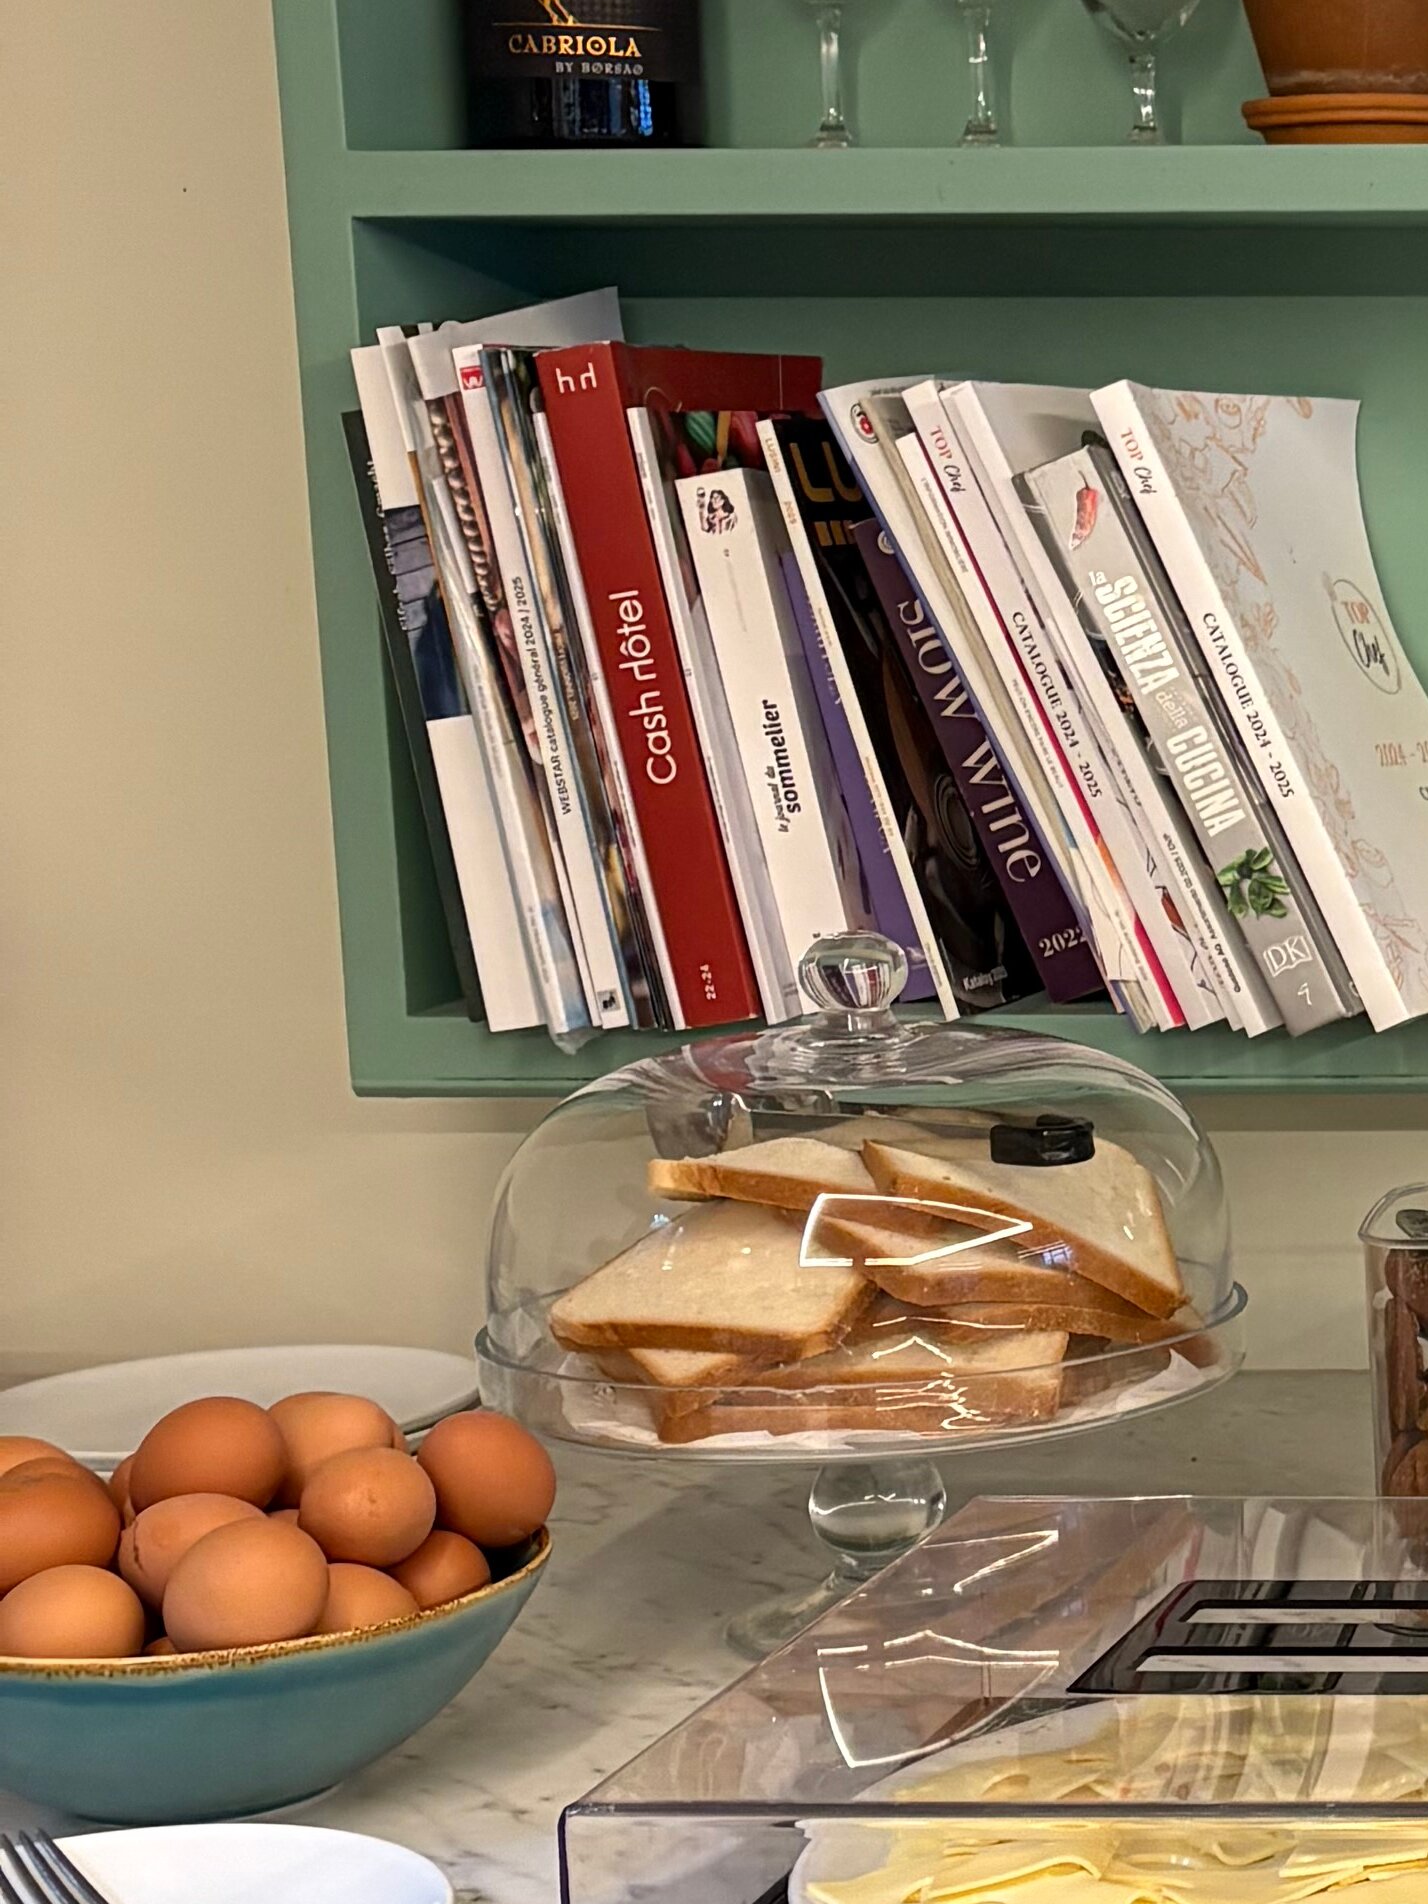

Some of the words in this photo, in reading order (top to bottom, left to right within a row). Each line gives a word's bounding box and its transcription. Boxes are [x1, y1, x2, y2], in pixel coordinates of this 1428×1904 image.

[508, 34, 642, 58] CABRIOLA
[555, 61, 574, 74] BY
[929, 425, 953, 460] TOP
[1119, 427, 1144, 462] TOP
[511, 575, 528, 605] 2025
[1088, 571, 1107, 586] la
[521, 616, 537, 644] 2024
[1341, 601, 1371, 626] TOP
[1094, 574, 1180, 695] SCIENZA
[539, 688, 559, 753] catalogue
[1011, 611, 1065, 708] CATALOGUE
[1056, 708, 1080, 748] 2024
[1078, 761, 1103, 799] 2025
[1154, 690, 1190, 729] della
[1202, 612, 1256, 709] CATALOGUE
[1247, 709, 1272, 749] 2024
[1269, 761, 1295, 799] 2025
[628, 690, 678, 786] Cash
[1375, 743, 1407, 768] 2024
[761, 698, 802, 815] sommelier
[549, 753, 571, 815] WEBSTAR
[1166, 724, 1247, 838] CUCINA
[1268, 938, 1305, 971] DK
